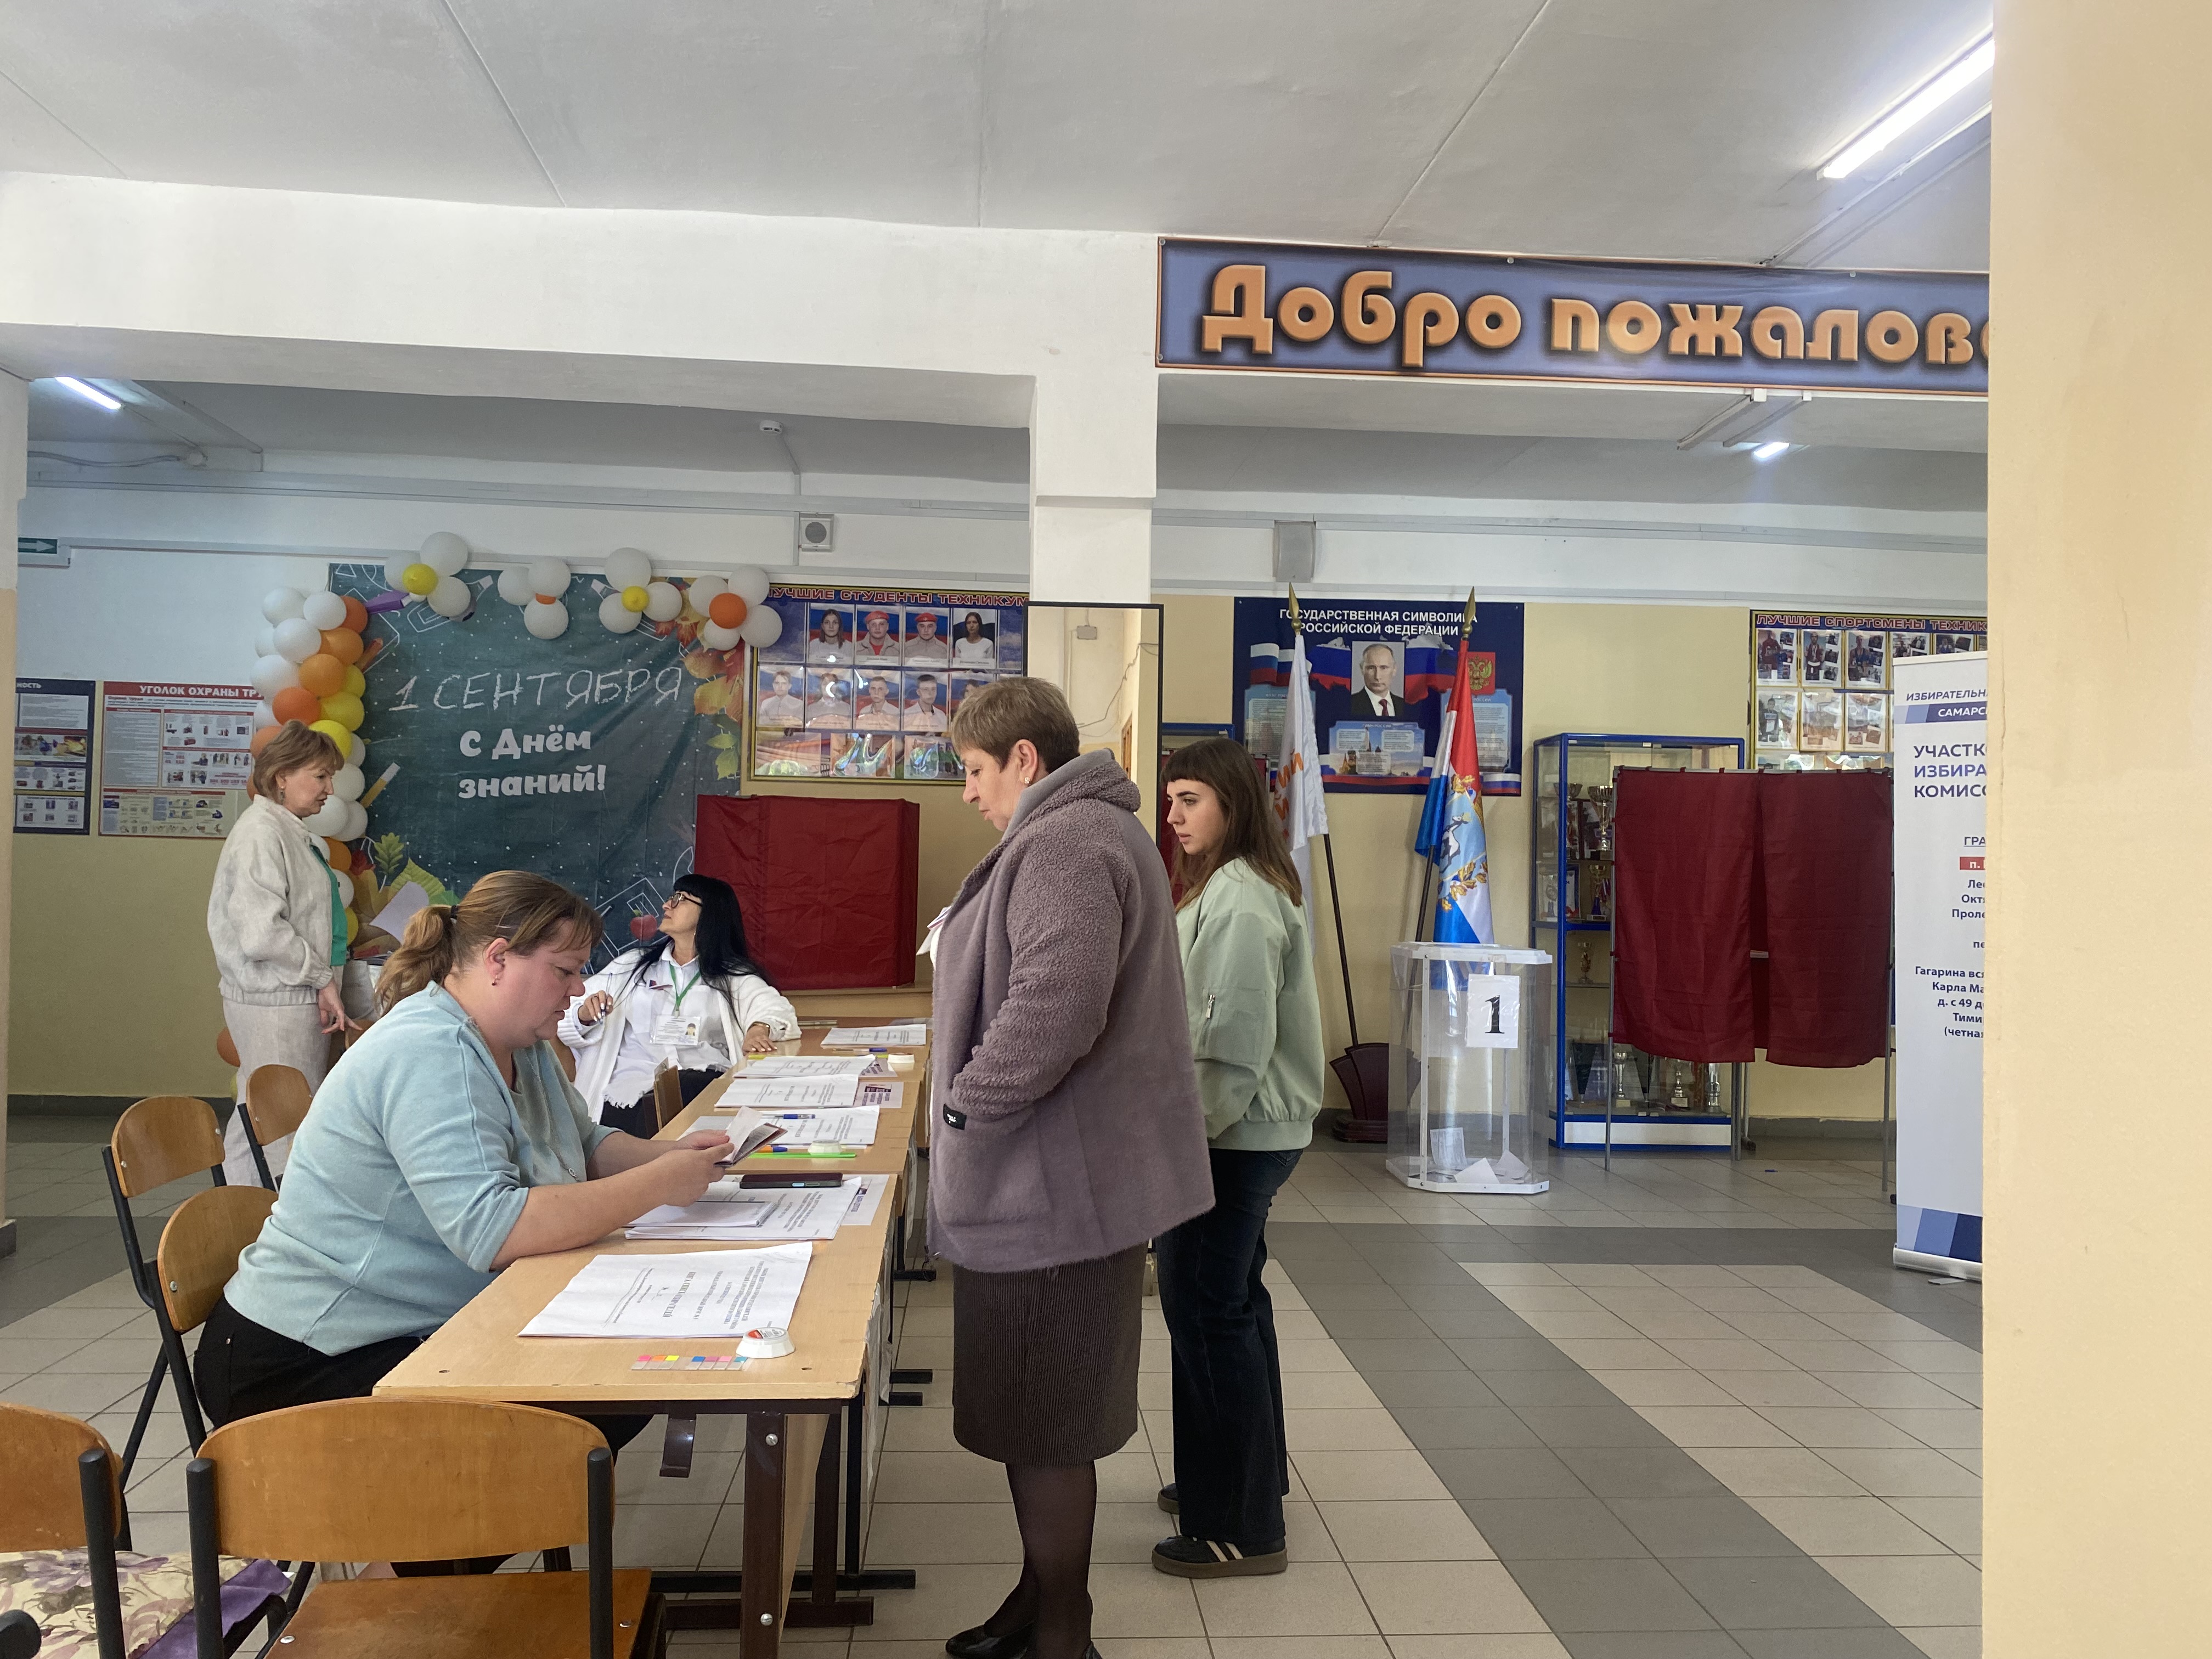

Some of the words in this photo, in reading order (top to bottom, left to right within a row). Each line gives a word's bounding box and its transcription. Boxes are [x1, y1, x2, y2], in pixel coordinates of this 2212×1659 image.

[1201, 264, 1521, 368] Добро
[840, 590, 933, 603] СТУДЕНТЫ
[1757, 614, 1820, 627] ЛУЧШИЕ
[1825, 616, 1926, 630] СПОРТСМЕНЫ
[1384, 624, 1459, 637] ФЕДЕРАЦИИ
[139, 685, 185, 696] УГОЛОК
[188, 687, 239, 697] ОХРАНЫ
[388, 675, 419, 712] 1
[433, 667, 682, 710] СЕНТЯБРЯ
[1906, 689, 1988, 701] ИЗБИРАТЕЛЬН
[1938, 707, 1988, 717] САМАРС
[492, 725, 591, 760] Днём
[1914, 743, 1987, 758] УЧАСТК
[1914, 764, 1987, 778] ИЗБИРА
[458, 765, 606, 799] знаний!
[1915, 966, 1966, 978] Гагарина
[1932, 981, 1966, 993] Карла
[1938, 999, 1948, 1007] д.
[1959, 998, 1972, 1007] 49
[1974, 1001, 1984, 1010] д
[1485, 995, 1505, 1034] 1
[1953, 1012, 1984, 1023] Тими
